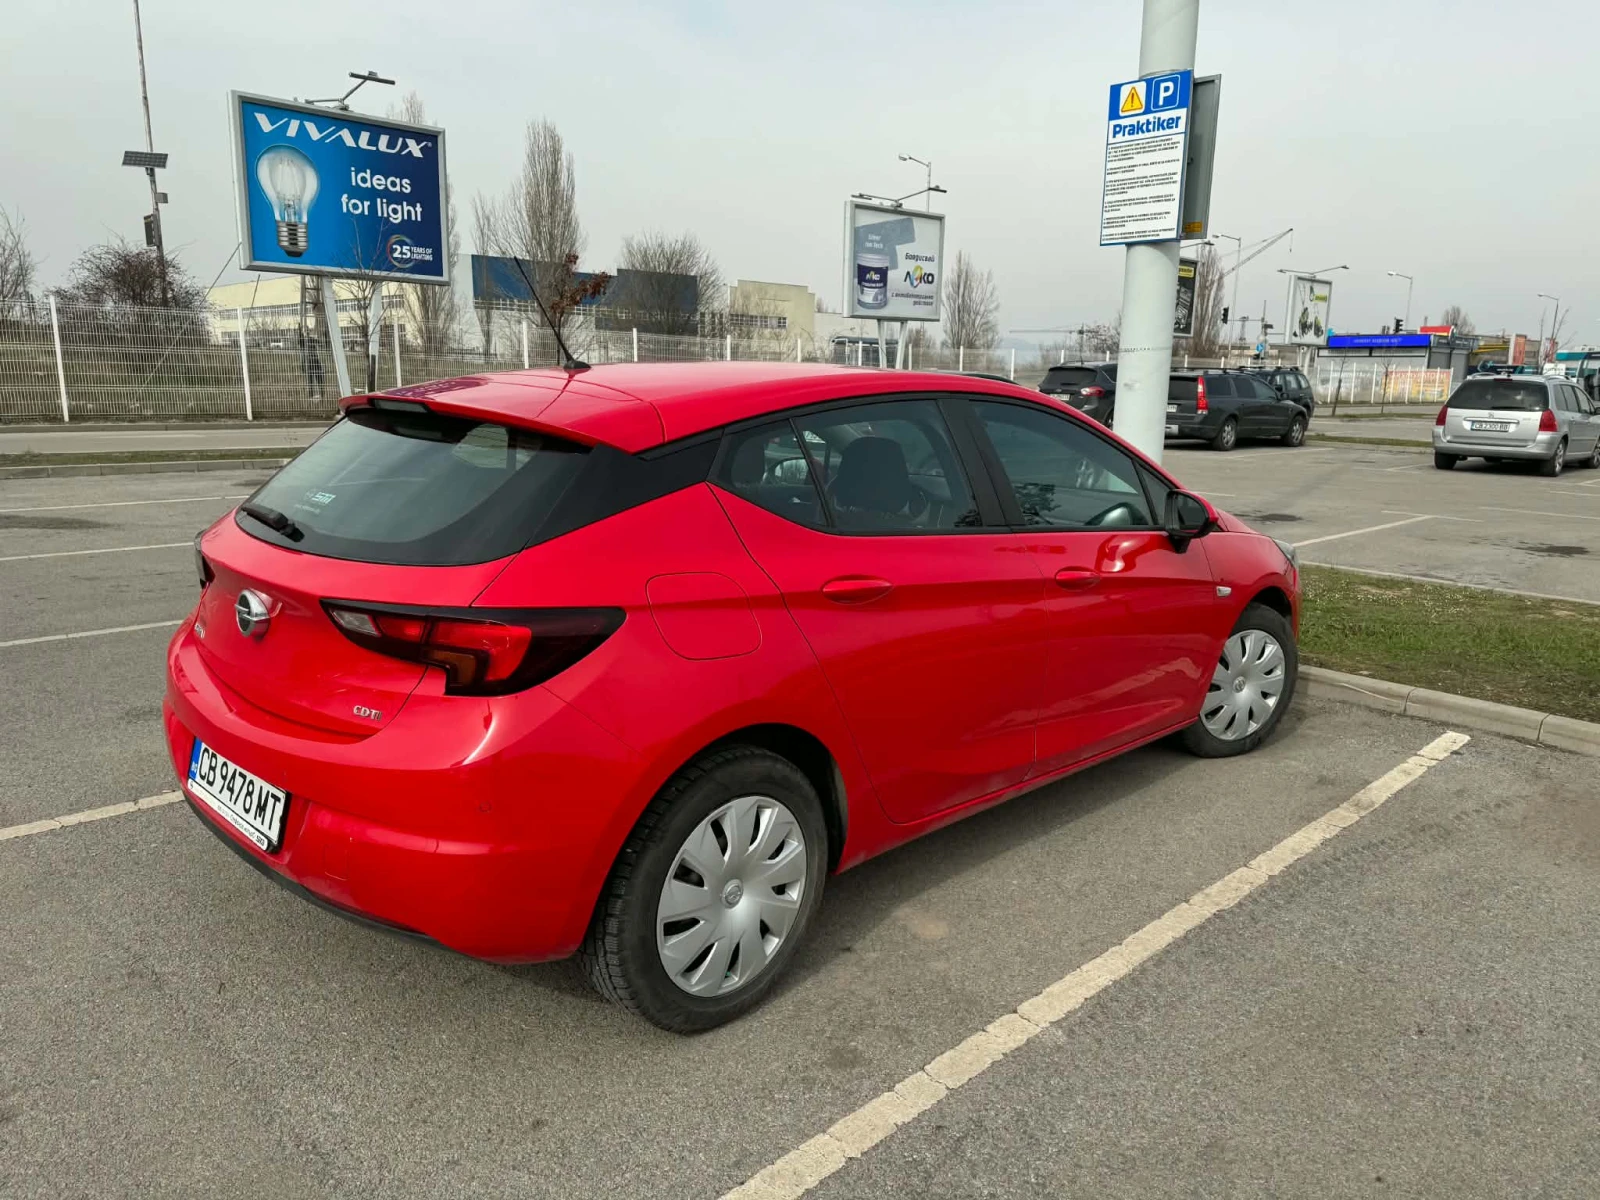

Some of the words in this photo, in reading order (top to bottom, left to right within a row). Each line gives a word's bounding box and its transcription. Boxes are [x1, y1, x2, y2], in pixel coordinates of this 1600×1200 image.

[1159, 81, 1174, 106] P
[254, 112, 428, 158] VIVALUX
[1112, 115, 1181, 139] Praktiker
[350, 167, 412, 194] ideas
[341, 194, 371, 215] for
[377, 199, 423, 223] light
[392, 244, 411, 259] 25
[411, 246, 426, 254] YEARS
